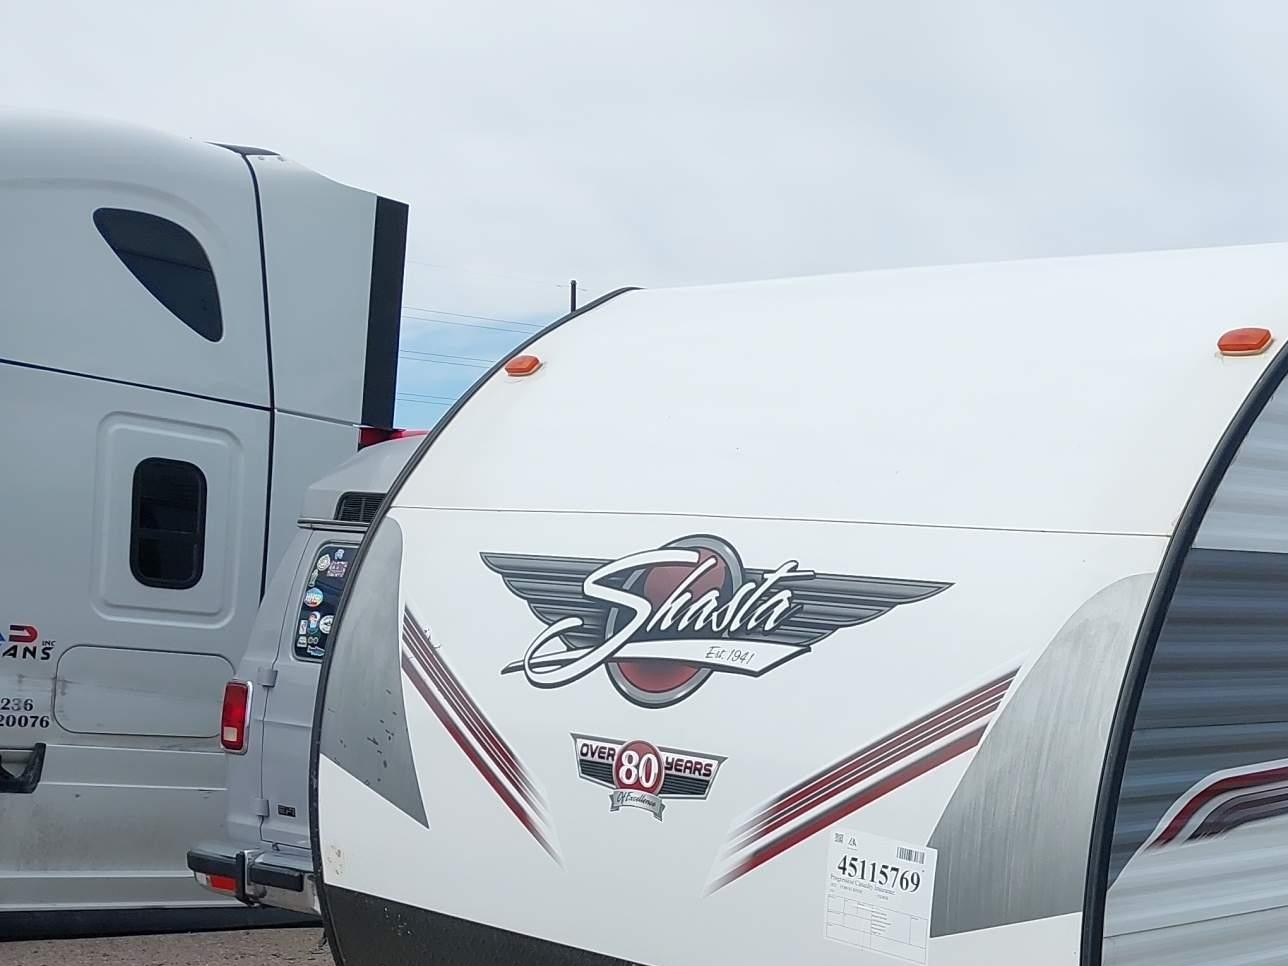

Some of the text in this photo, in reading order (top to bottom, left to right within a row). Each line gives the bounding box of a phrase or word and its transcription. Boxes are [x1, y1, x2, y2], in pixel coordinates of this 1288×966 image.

[524, 548, 815, 688] Shasta
[727, 649, 756, 664] 1941
[580, 742, 714, 788] OVER 80 YEARS
[837, 854, 921, 893] 45115769
